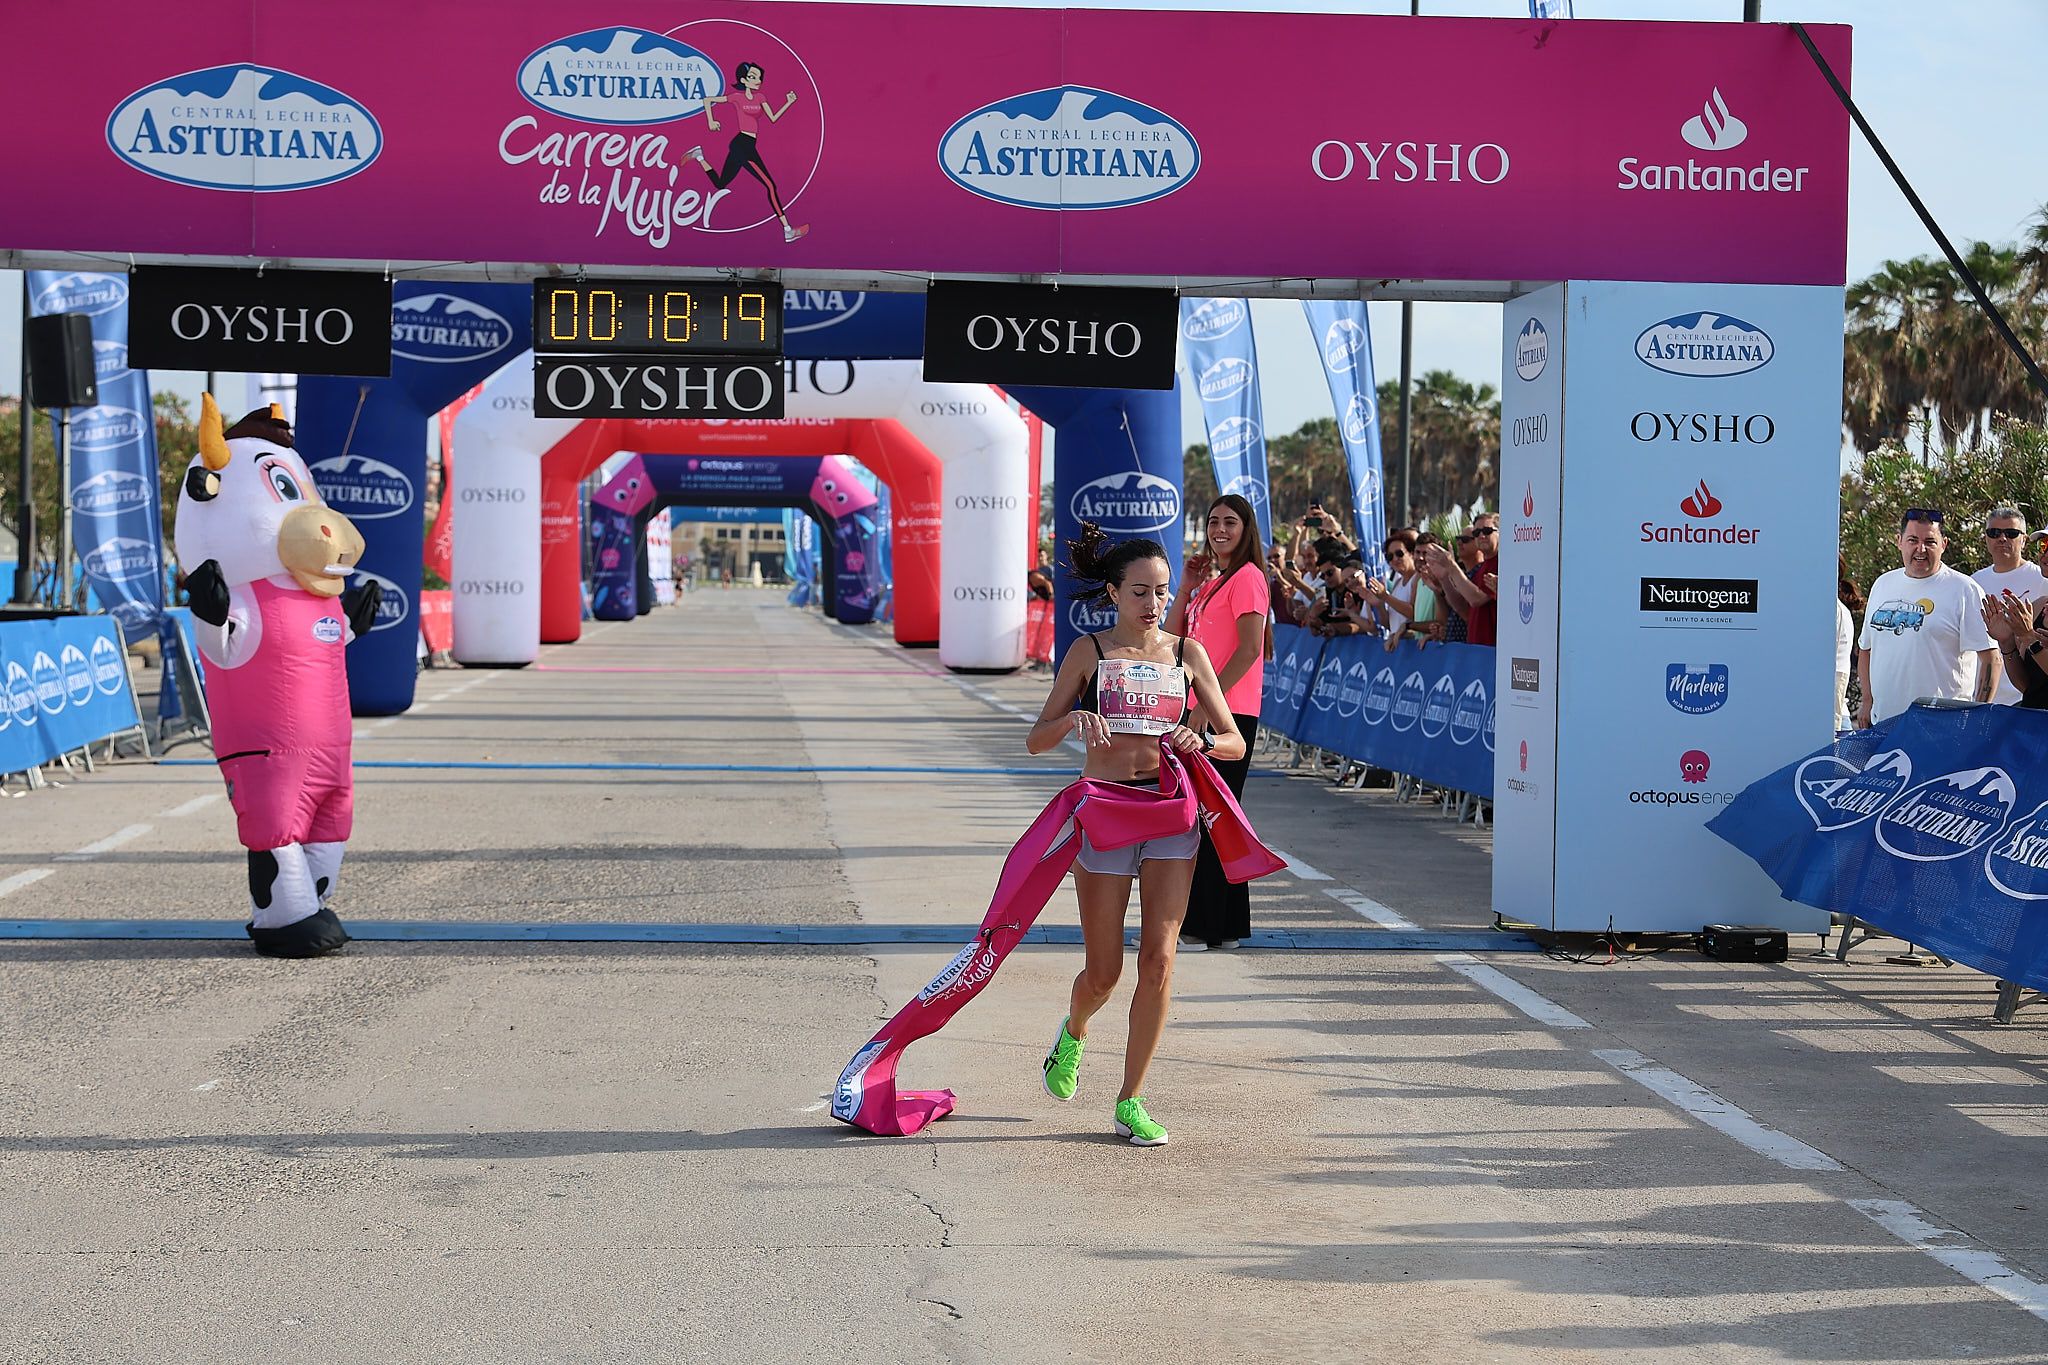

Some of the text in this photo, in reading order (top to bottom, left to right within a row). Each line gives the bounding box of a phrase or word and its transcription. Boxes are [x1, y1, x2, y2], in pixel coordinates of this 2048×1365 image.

[566, 59, 702, 72] CENTRAL LECHERA
[533, 61, 708, 101] ASTURIANA
[171, 106, 352, 123] CENTRAL LECHERA
[128, 108, 361, 160] ASTURIANA
[499, 115, 669, 166] Carrera
[1000, 128, 1172, 142] CENTRAL LECHERA
[959, 130, 1180, 178] ASTURIANA
[1311, 139, 1510, 185] OYSHO
[1618, 157, 1810, 193] Santander
[540, 165, 732, 249] de la Mujer
[171, 302, 354, 346] OYSHO
[550, 289, 766, 343] 00:18:19
[392, 323, 500, 348] STURIANA
[967, 313, 1142, 360] OYSHO
[1644, 334, 1765, 362] ASTURIANA
[1666, 333, 1761, 343] CENTRAL LECHERA
[1517, 342, 1546, 368] ASTURIANA
[545, 364, 773, 413] OYSHO
[492, 396, 536, 411] OYS
[921, 402, 987, 416] OYSHO
[1513, 413, 1548, 447] OYSHO
[1631, 411, 1775, 444] OYSHO
[461, 487, 525, 503] OYSHO
[955, 496, 1017, 511] OYSHO
[1078, 494, 1176, 517] ASTURIANA
[1513, 523, 1543, 543] Santander
[1640, 522, 1761, 545] Santander
[460, 580, 524, 596] OYSHO
[953, 587, 1016, 602] OYSHO
[1648, 584, 1750, 609] Neutrogena
[1126, 692, 1159, 706] 016
[1669, 674, 1725, 701] Marlene
[1108, 721, 1134, 729] OYSHO
[1883, 789, 1992, 848] ASTURIANA
